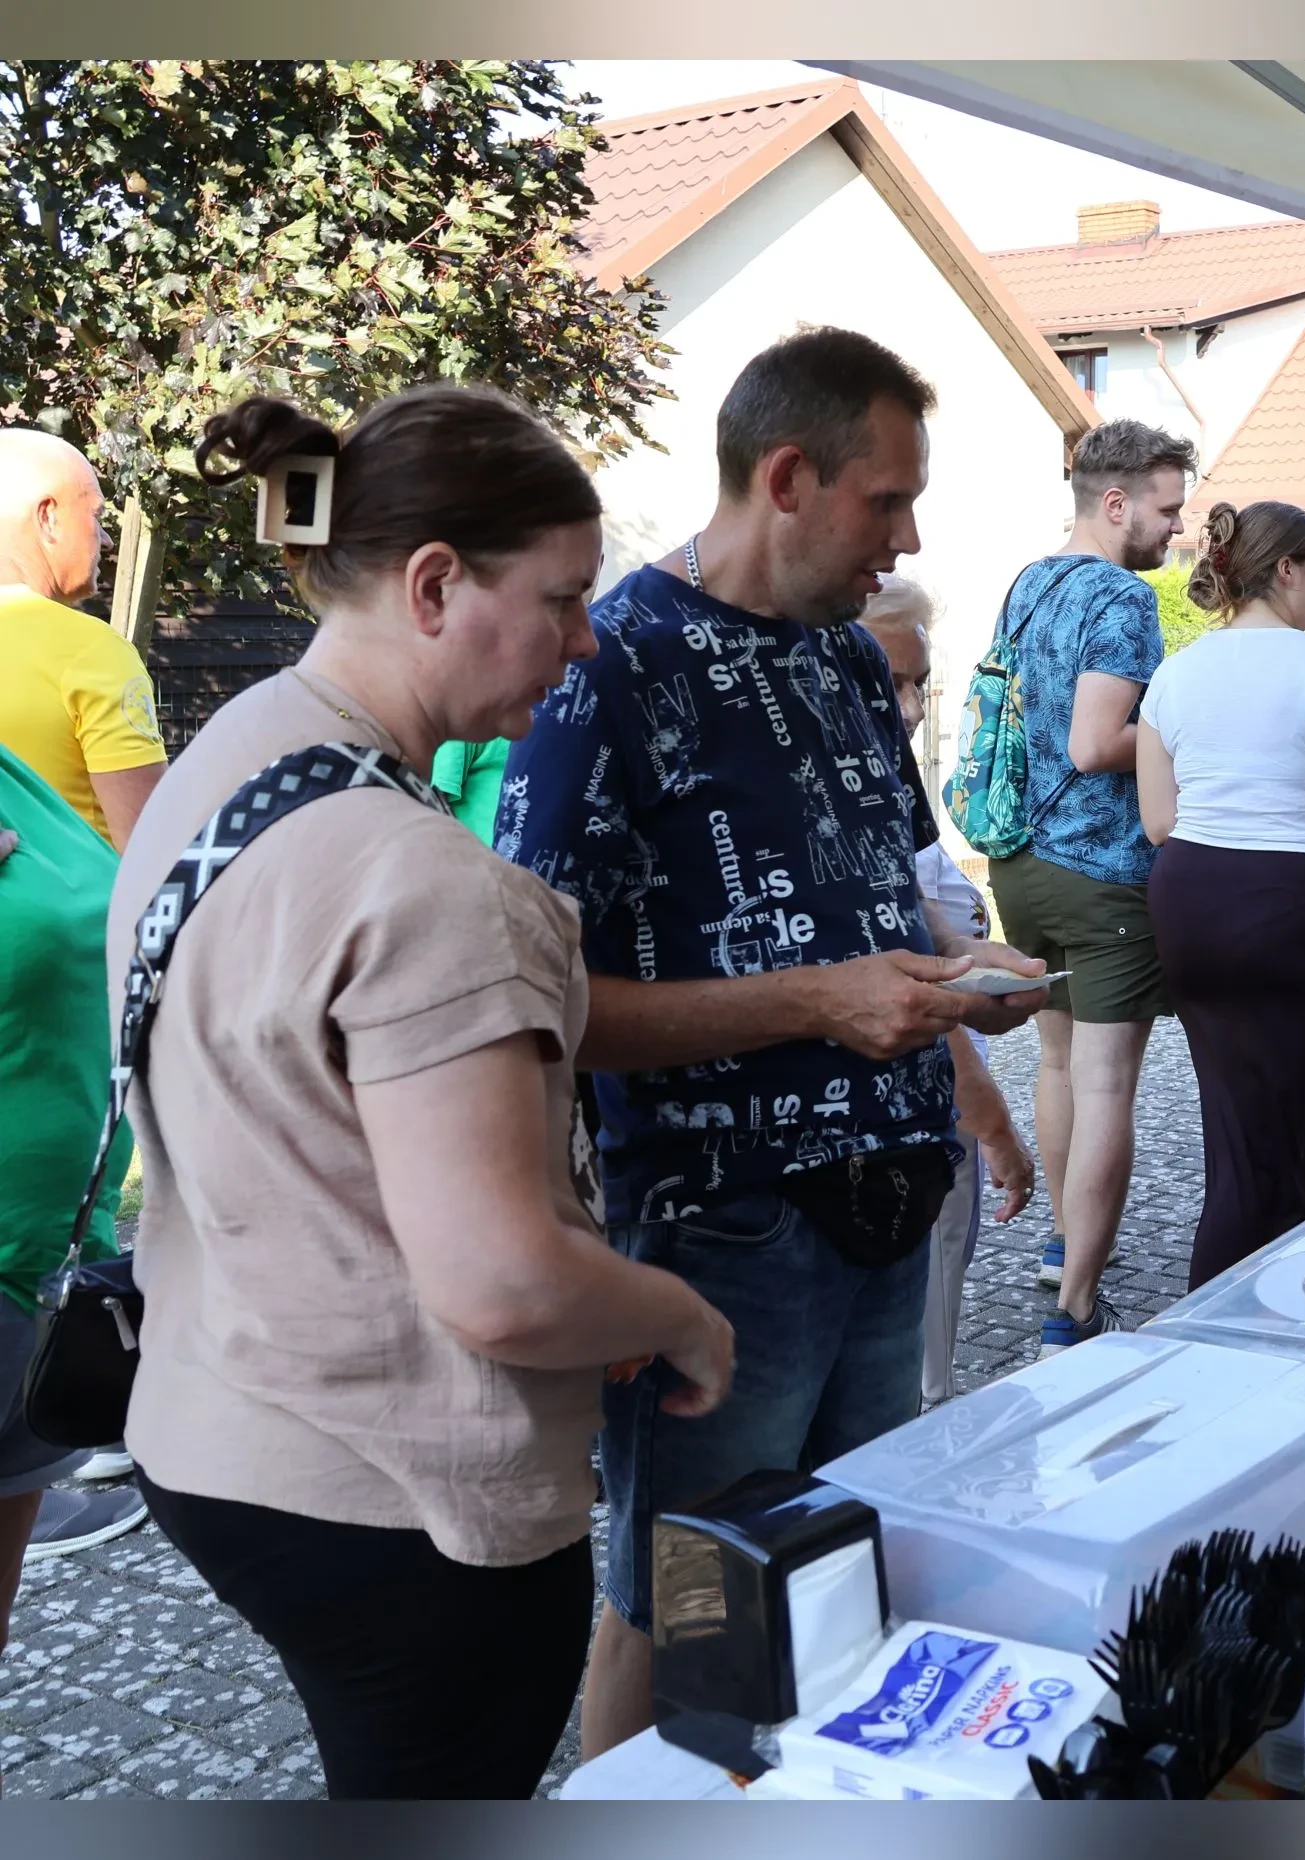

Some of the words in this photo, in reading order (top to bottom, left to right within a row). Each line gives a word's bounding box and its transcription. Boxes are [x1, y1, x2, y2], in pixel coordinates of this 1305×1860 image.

[748, 656, 793, 748] centure
[583, 744, 613, 803] IMAGINE
[707, 809, 748, 906] centure
[630, 899, 657, 982] enture
[699, 914, 753, 935] denim
[961, 1680, 1019, 1737] CLASSIC
[963, 1664, 1012, 1716] NAPKINS
